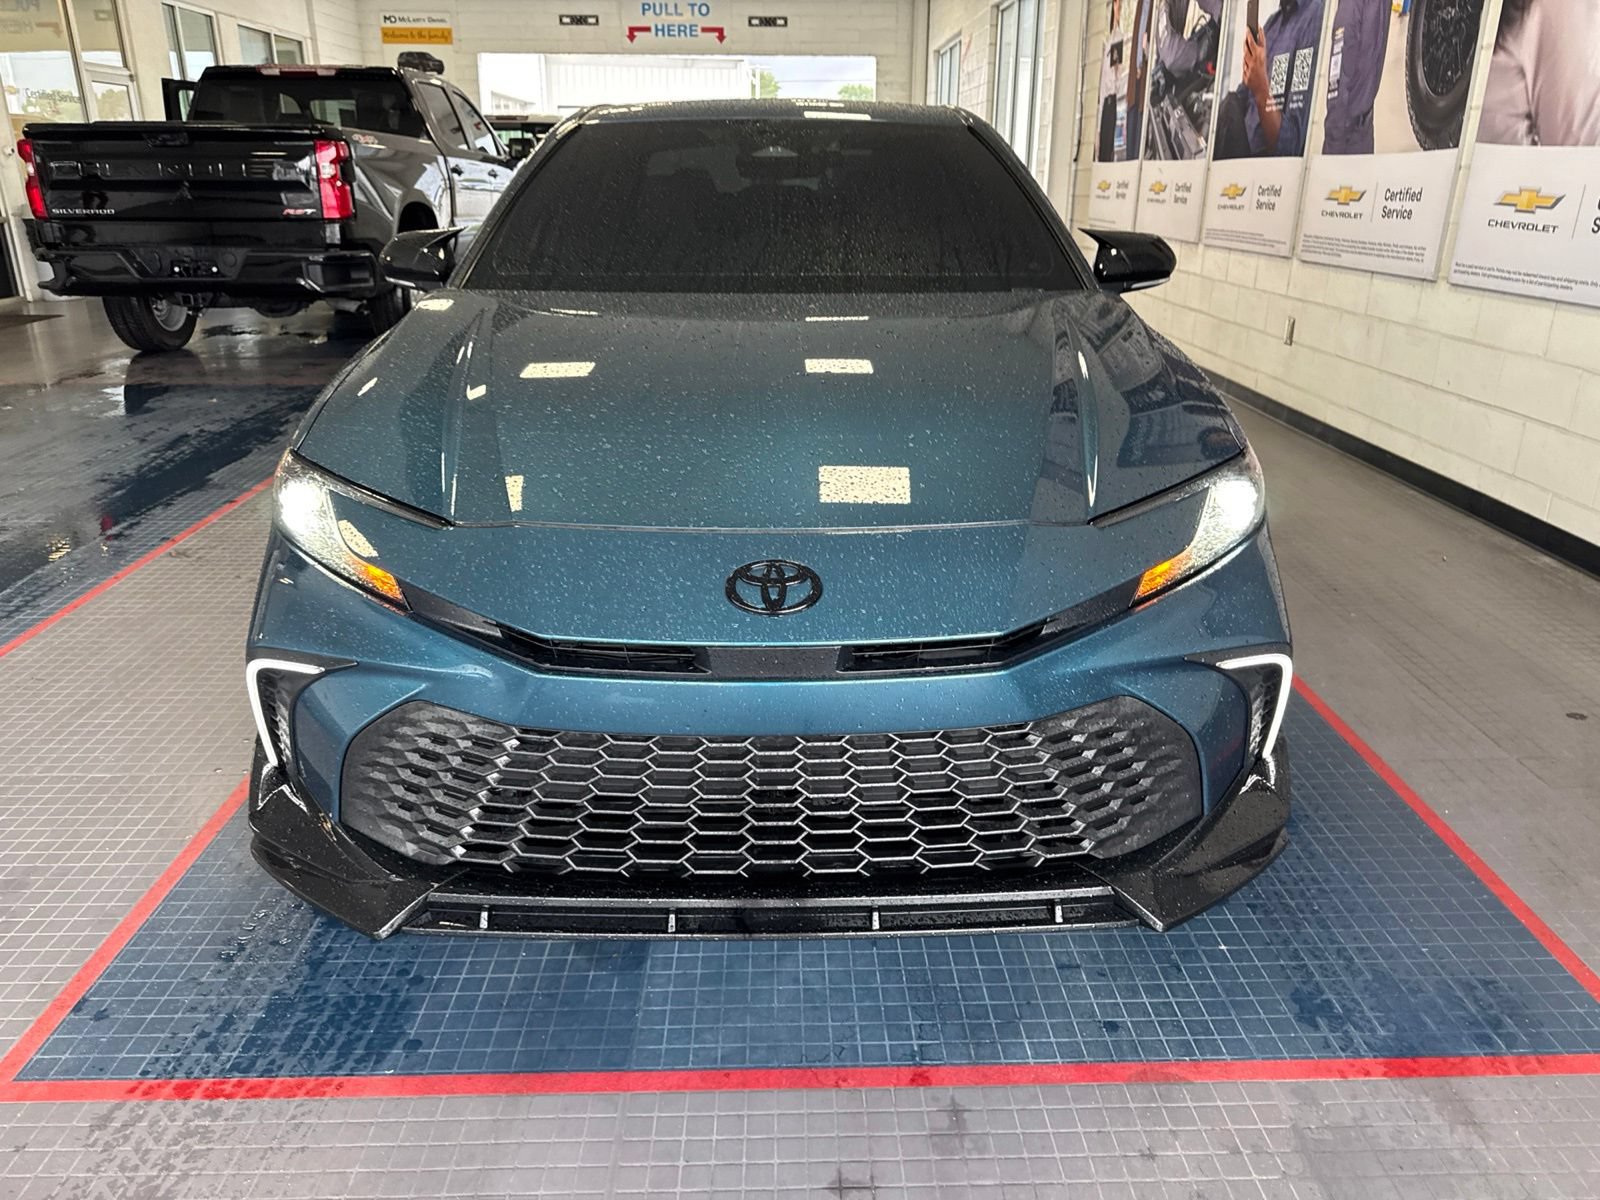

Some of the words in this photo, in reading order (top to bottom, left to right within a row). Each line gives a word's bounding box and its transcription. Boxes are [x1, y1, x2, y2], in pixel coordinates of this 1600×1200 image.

[641, 2, 683, 17] PULL
[687, 2, 711, 17] TO
[654, 23, 700, 38] HERE
[1257, 184, 1283, 198] Certified
[1384, 186, 1424, 203] Certified
[1255, 198, 1276, 212] Service
[1381, 204, 1413, 220] Service
[1321, 209, 1364, 220] CHEVROLET
[1487, 218, 1560, 234] CHEVROLET
